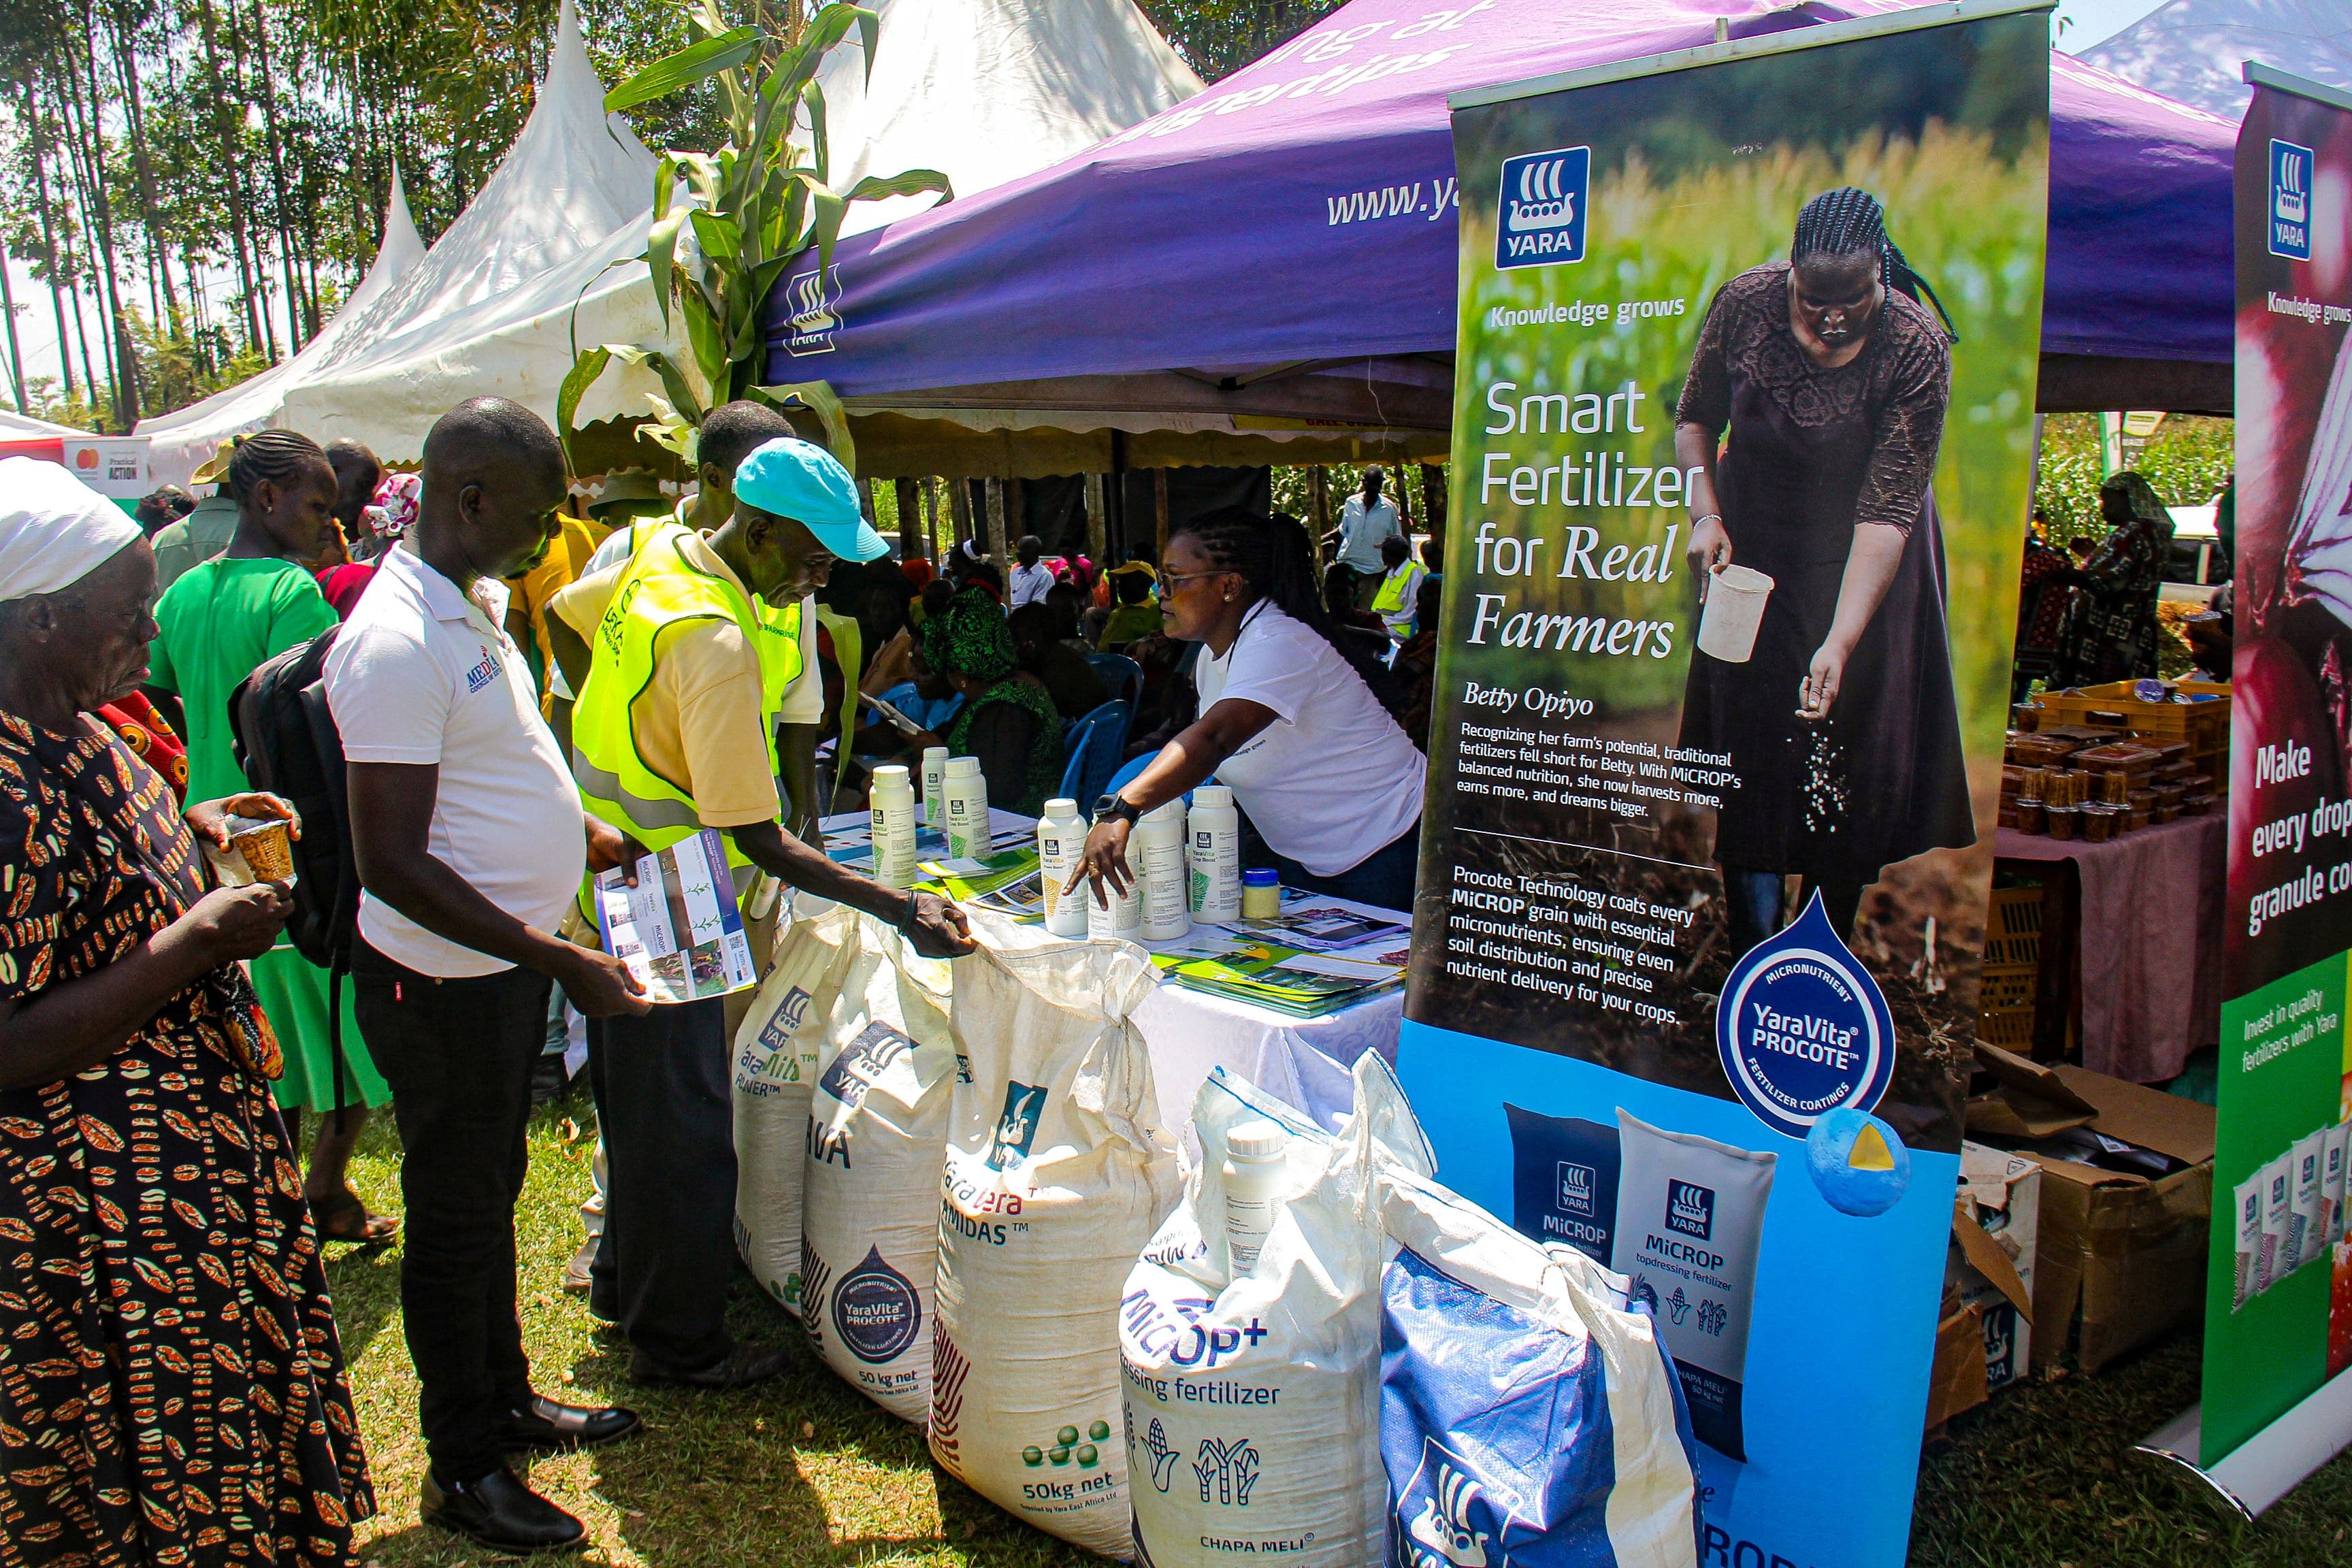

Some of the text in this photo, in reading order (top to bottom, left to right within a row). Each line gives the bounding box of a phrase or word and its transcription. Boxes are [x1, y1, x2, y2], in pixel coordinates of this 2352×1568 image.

[1507, 231, 1572, 257] YARA
[2276, 223, 2304, 248] YARA
[1491, 297, 1685, 327] Knowledge grows
[2268, 291, 2351, 325] Knowledge grows
[1486, 381, 1646, 435] Smart
[109, 467, 137, 480] ACTION
[1481, 452, 1704, 508] Fertilizer
[1474, 522, 1678, 583] for Real
[1467, 593, 1675, 659] Farmers
[467, 654, 500, 687] MEDIA
[1463, 682, 1593, 719] Betty Opiyo
[1462, 723, 1731, 766] Recognizing her farm's potential, traditional
[1460, 741, 1741, 788] fertilizers fell short for Betty. With MiCROP's
[2255, 739, 2310, 789] Make
[1457, 781, 1648, 817] earns more, and dreams bigger.
[1459, 760, 1722, 808] balanced nutrition, she now harvests more,
[2253, 796, 2352, 858] every drop
[1454, 866, 1694, 930] Procote Technology coats every
[2249, 862, 2352, 937] granule co
[1452, 889, 1675, 947] MiCROP grain with essential
[1448, 910, 1673, 972] micronutrients, ensuring even
[738, 950, 749, 976] farmcare
[1448, 938, 1652, 992] soil distribution and precise
[1448, 962, 1681, 1025] nutrient delivery for your crops.
[1765, 964, 1852, 1003] MICRONUTRIENT
[2244, 989, 2323, 1041] Invest in quality
[2242, 1013, 2338, 1073] fertilizers with Yara
[1748, 1057, 1850, 1111] FERTILIZER COATINGS
[1563, 1196, 1589, 1211] YARA
[1544, 1215, 1606, 1244] MiCROP
[1671, 1215, 1705, 1236] YARA
[1646, 1233, 1724, 1271] MiCROP
[849, 1281, 898, 1293] MICRONUTRIENT
[1635, 1252, 1732, 1291] topdressing fertilizer
[859, 1370, 917, 1387] 50 kg net
[1173, 1377, 1281, 1405] fertilizer
[1679, 1369, 1701, 1385] HAPA
[1693, 1386, 1701, 1394] 50
[1704, 1390, 1711, 1399] kg
[1023, 1471, 1112, 1499] 50kg net
[1069, 1503, 1083, 1511] East
[1085, 1497, 1105, 1507] Africa
[1106, 1492, 1117, 1500] Ltd
[1200, 1536, 1256, 1552] CHAPA
